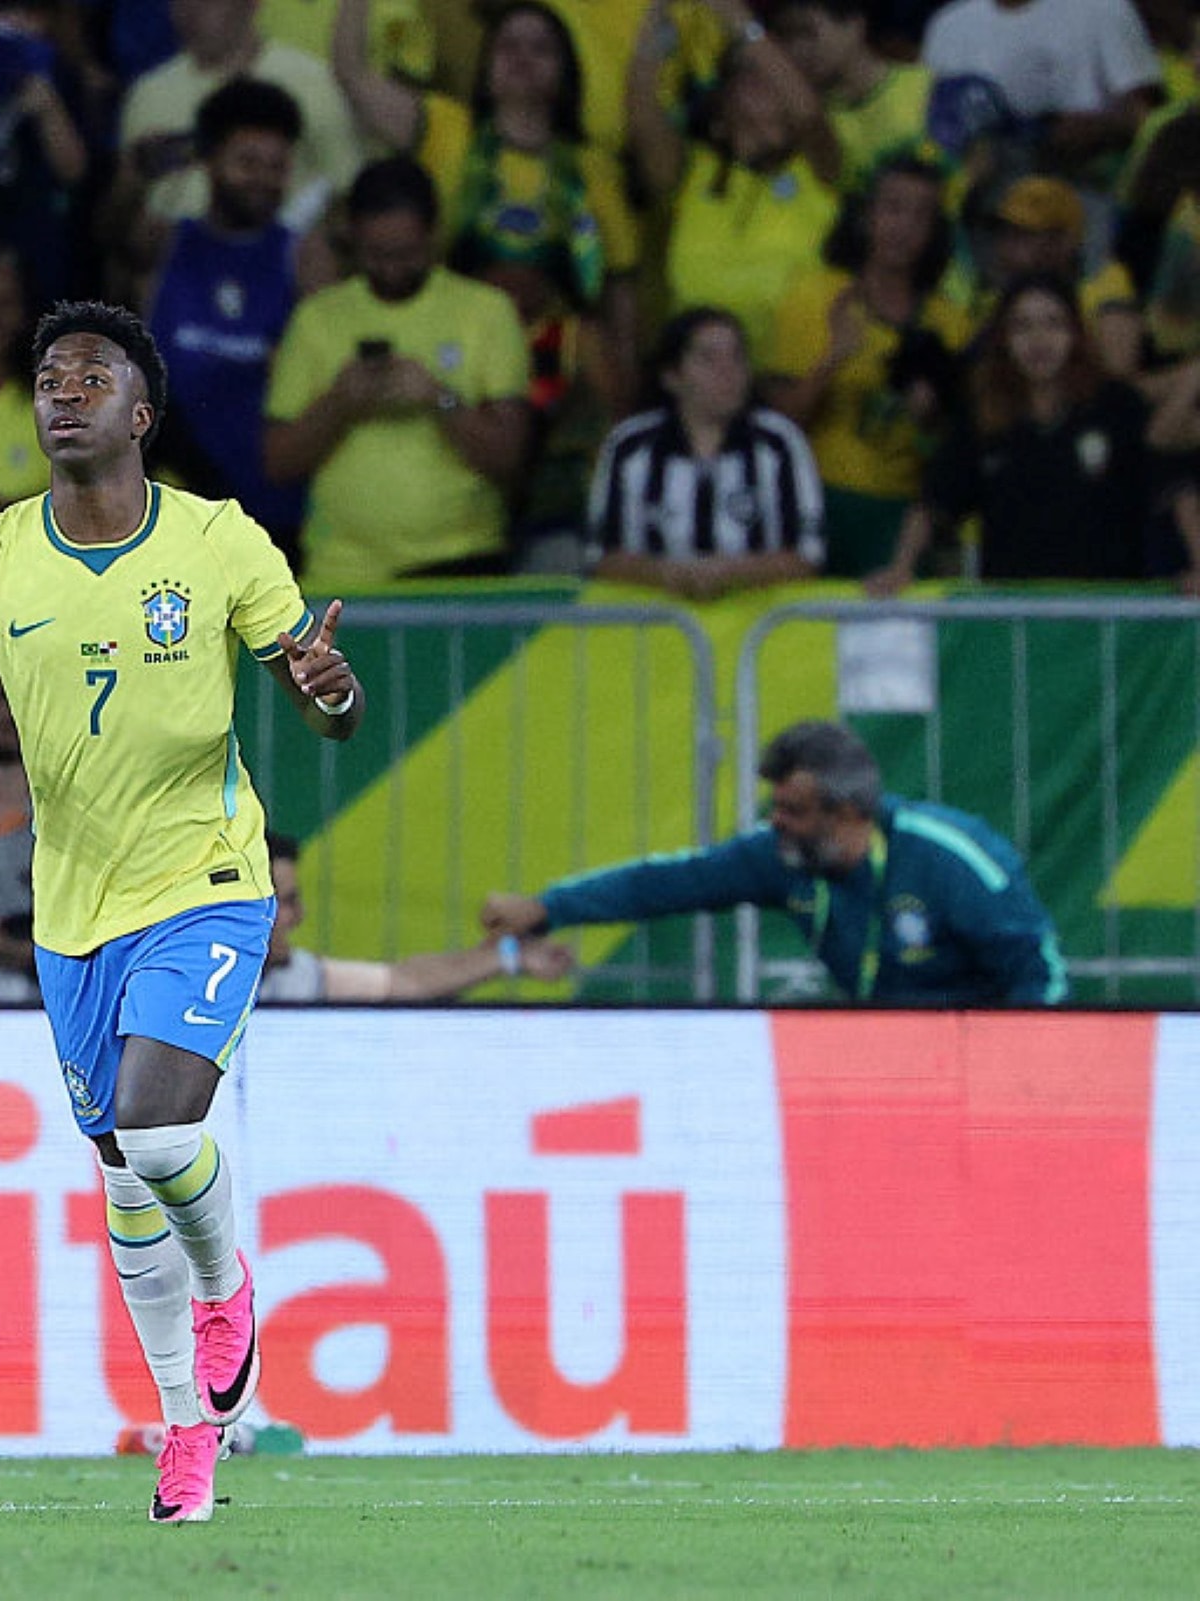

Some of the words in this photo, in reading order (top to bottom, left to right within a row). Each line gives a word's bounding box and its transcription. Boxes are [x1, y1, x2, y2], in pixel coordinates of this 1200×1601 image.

[144, 650, 190, 664] BRASIL
[85, 669, 117, 735] 7
[205, 942, 237, 1003] 7
